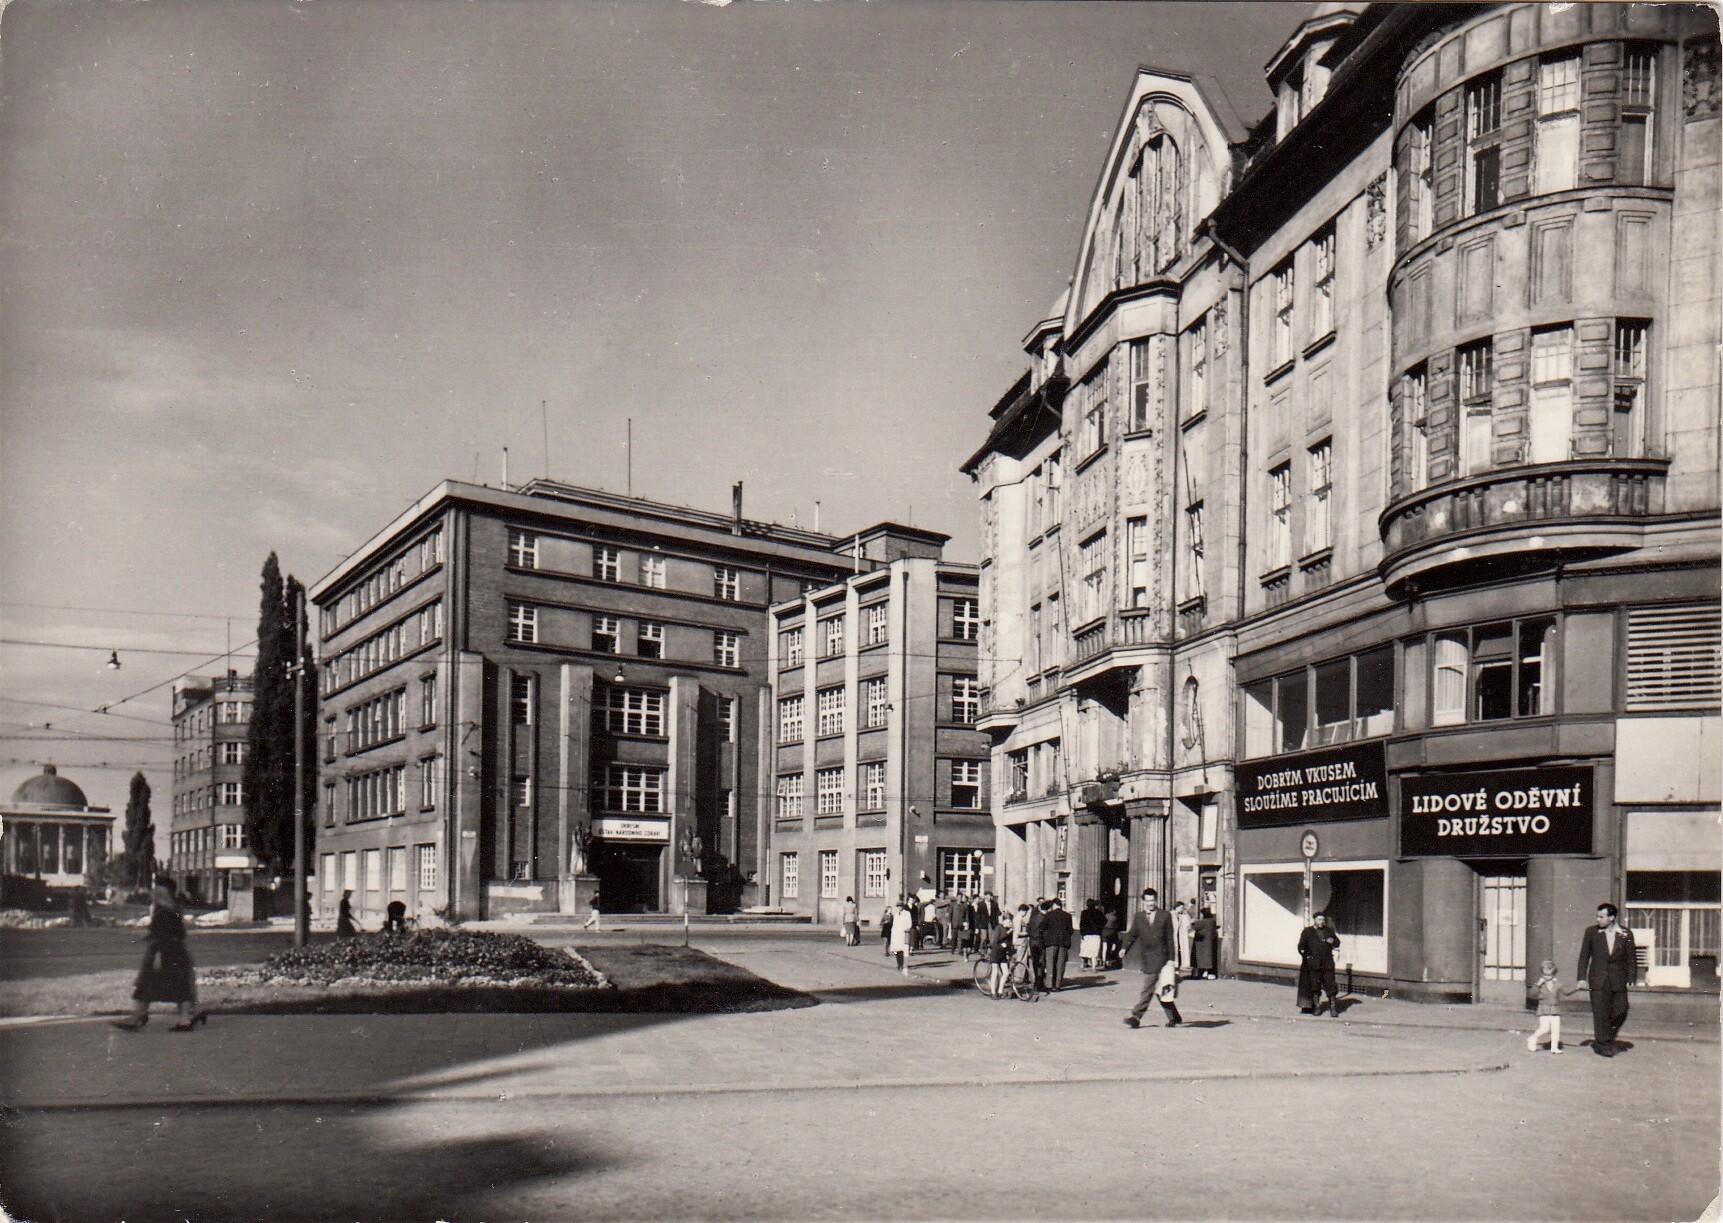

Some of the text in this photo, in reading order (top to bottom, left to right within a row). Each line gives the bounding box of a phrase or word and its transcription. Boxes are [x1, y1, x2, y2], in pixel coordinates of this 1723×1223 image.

[1257, 762, 1357, 790] DOBRÝM VKUSEM
[1244, 779, 1378, 812] SLOUŽÍME PRACUJÍCÍM
[1412, 783, 1581, 813] LIDOVÉ ODĚVNÍ
[1437, 815, 1550, 836] DRUŽSTVO
